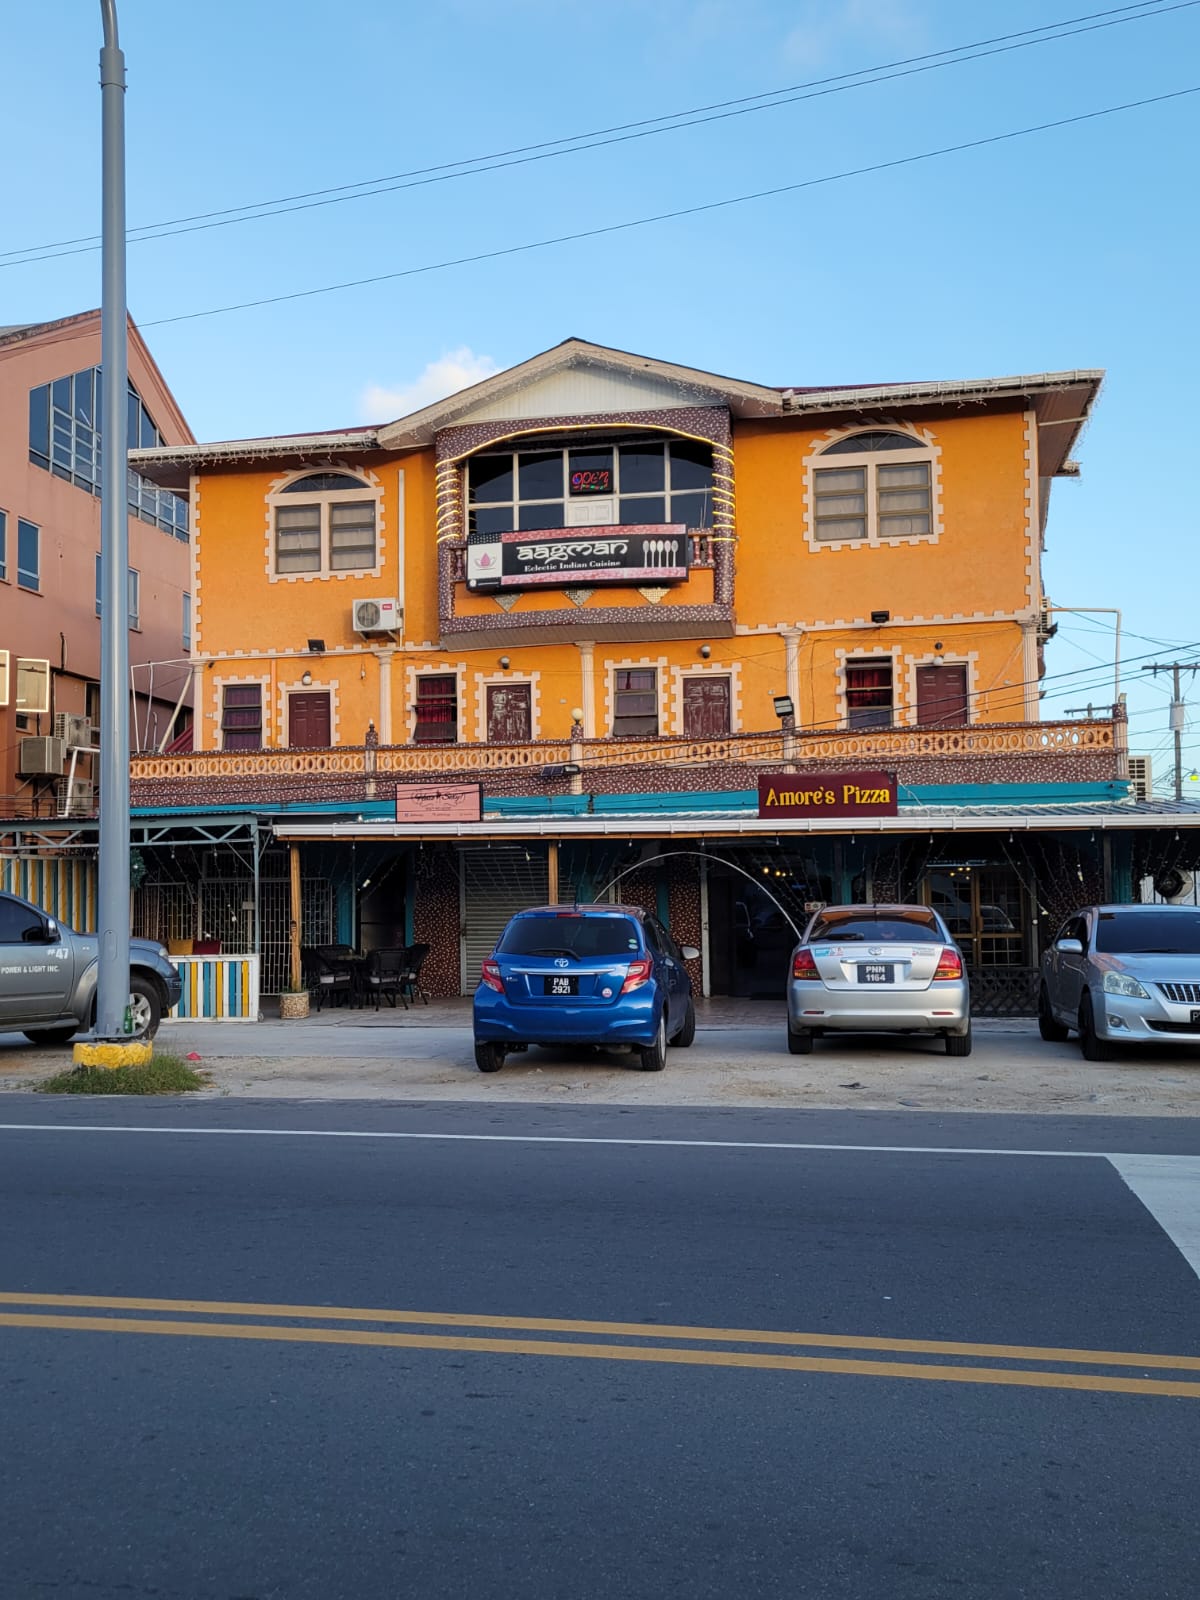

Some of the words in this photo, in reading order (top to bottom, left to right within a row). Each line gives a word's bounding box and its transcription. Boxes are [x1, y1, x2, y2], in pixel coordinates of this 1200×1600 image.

[516, 539, 629, 564] aagman
[524, 563, 557, 573] Eclectic
[559, 561, 587, 570] Indian
[589, 559, 621, 568] Cuisine
[765, 786, 835, 806] Amore's
[843, 784, 890, 804] Pizza
[1, 966, 21, 974] POWER
[28, 965, 46, 973] LIGHT
[552, 985, 571, 994] 2921
